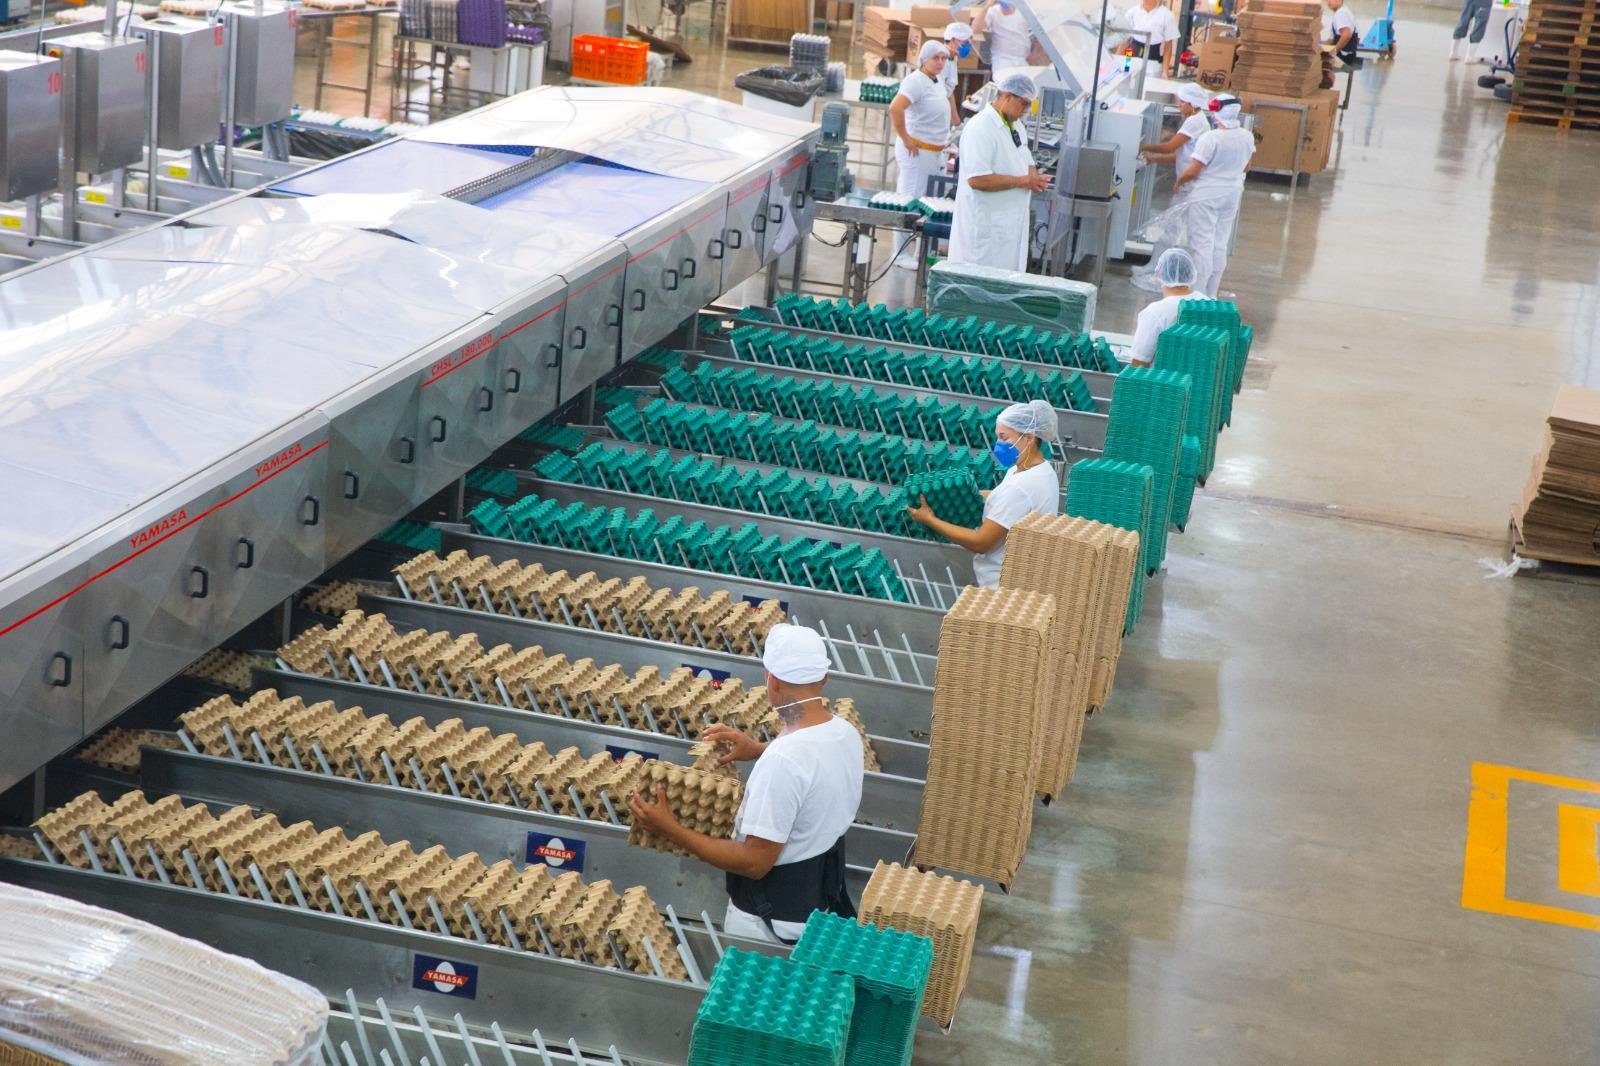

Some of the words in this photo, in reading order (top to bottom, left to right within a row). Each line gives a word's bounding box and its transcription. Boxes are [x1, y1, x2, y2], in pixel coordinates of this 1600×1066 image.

[135, 52, 145, 74] 11
[48, 72, 60, 93] 10
[255, 443, 302, 477] YAMASA
[130, 509, 187, 549] YAMASA
[539, 847, 572, 859] YAMASA
[427, 971, 464, 985] YAMASA
